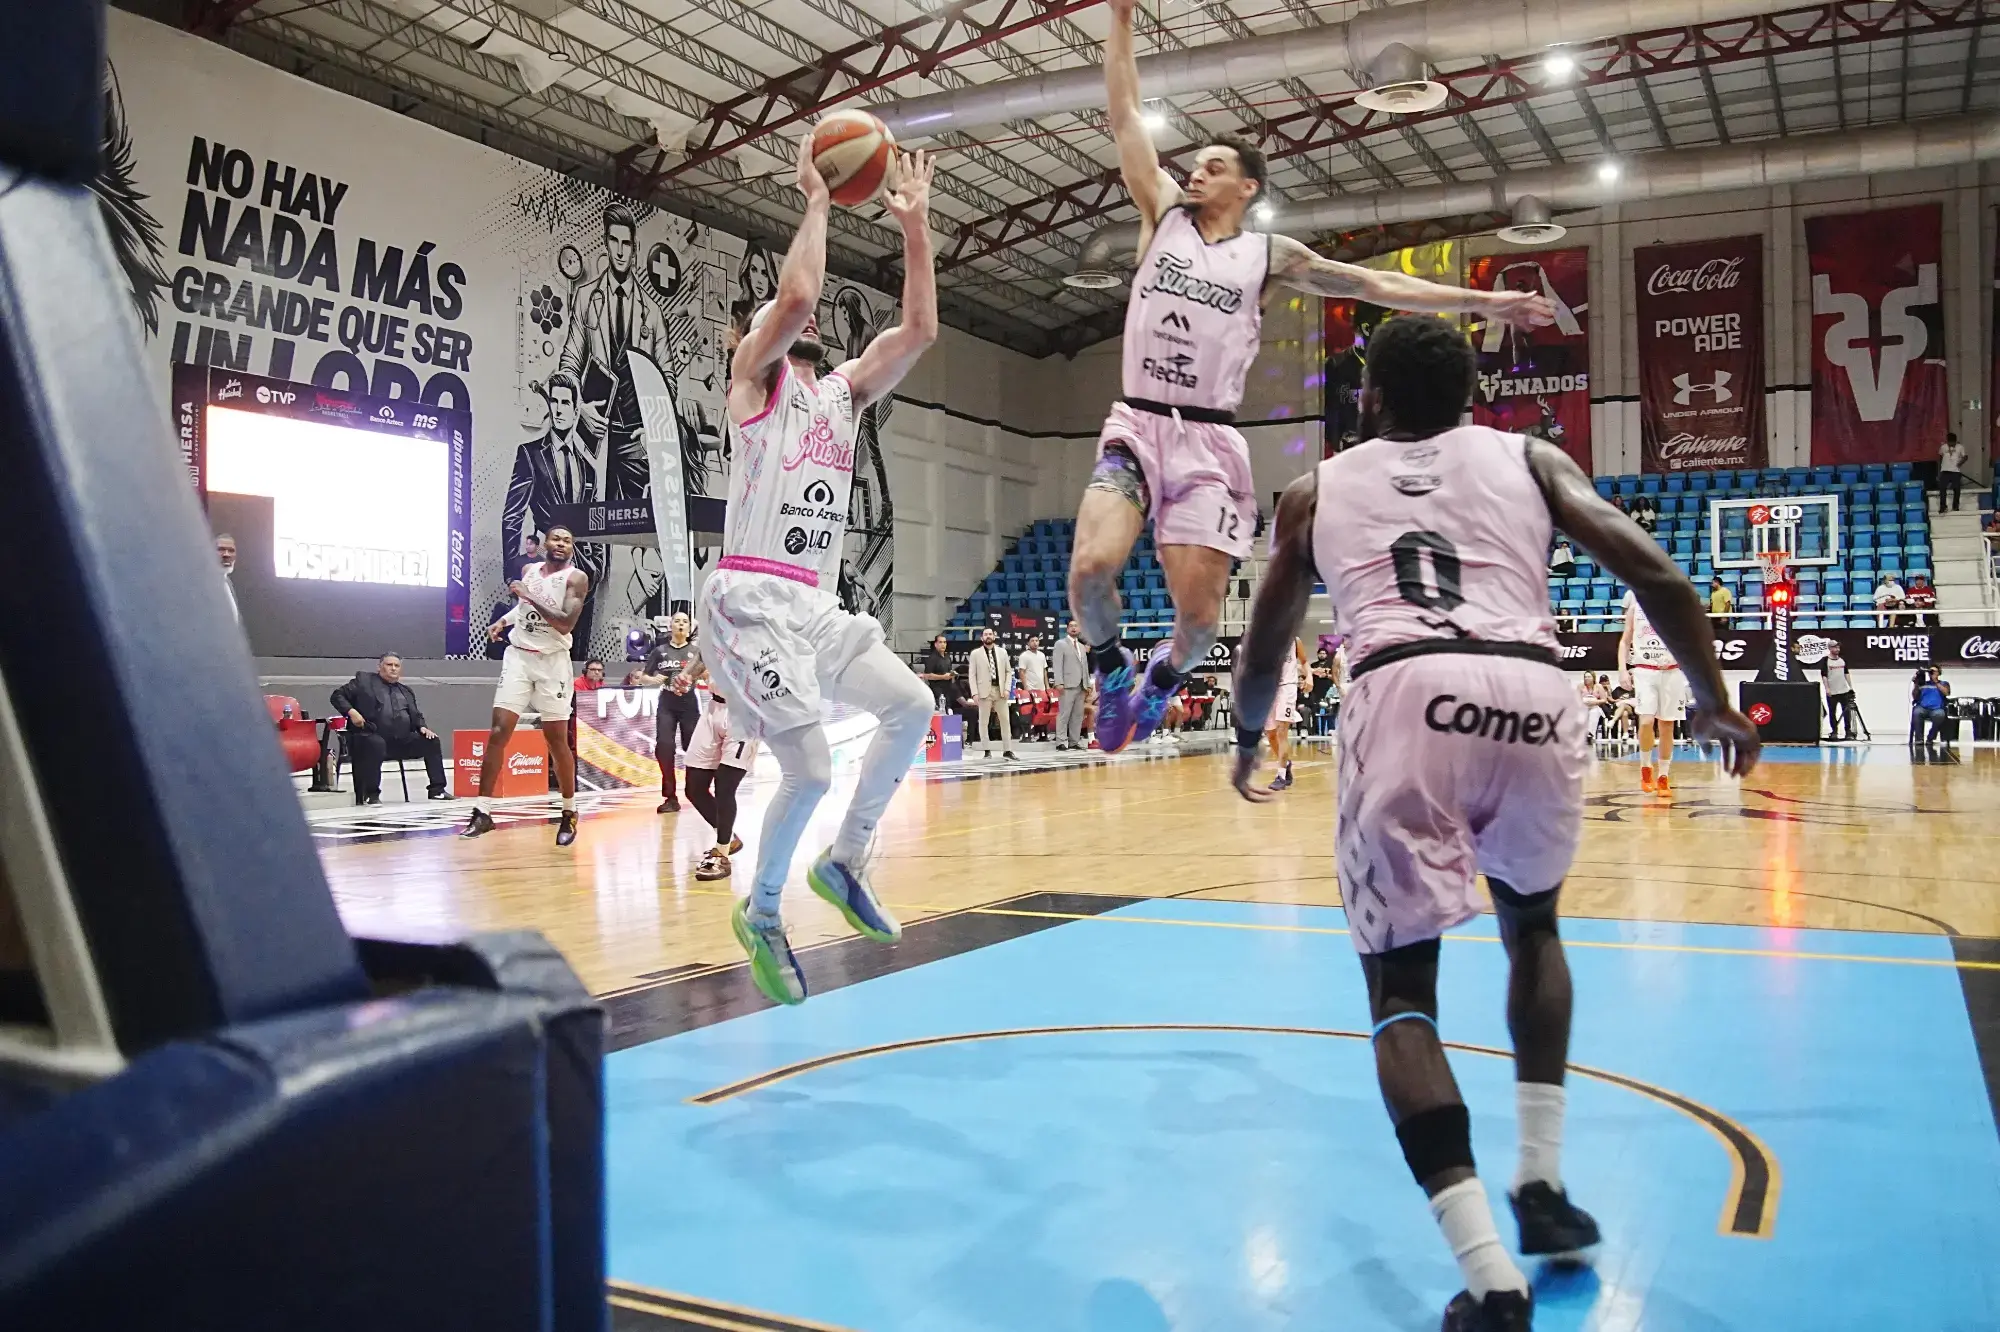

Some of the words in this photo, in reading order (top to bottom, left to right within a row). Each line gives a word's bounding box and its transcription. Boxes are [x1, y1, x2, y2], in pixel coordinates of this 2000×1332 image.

[187, 136, 254, 198] NO
[260, 159, 349, 226] HAY
[178, 189, 340, 292] NADA
[351, 237, 467, 321] MÁS
[1647, 257, 1745, 295] Coca-Cola
[172, 266, 335, 342] GRANDE
[338, 305, 409, 358] QUE
[412, 323, 472, 372] SER
[1655, 313, 1741, 337] POWER
[1694, 331, 1741, 352] ADE
[271, 390, 296, 404] TVP
[1477, 369, 1589, 402] VENADOS
[412, 413, 439, 430] ms
[1663, 410, 1698, 418] UNDER
[1700, 407, 1744, 416] ARMOUR
[181, 401, 193, 464] HERSA
[1661, 432, 1747, 459] Caliente
[453, 429, 464, 515] dportenis
[1682, 456, 1745, 467] caliente.mx
[608, 508, 648, 520] HERSA
[780, 503, 814, 517] Banco
[1770, 505, 1803, 520] CID
[1217, 506, 1239, 541] 12
[451, 529, 465, 587] telcel
[1390, 531, 1466, 611] 0
[1774, 606, 1788, 681] dportenis
[1866, 635, 1929, 649] POWER
[1960, 635, 2000, 659] Coca
[1895, 648, 1930, 661] ADE
[761, 687, 792, 702] MEGA
[1425, 694, 1564, 747] Comex
[735, 741, 745, 760] 1
[459, 759, 483, 767] CIBAC
